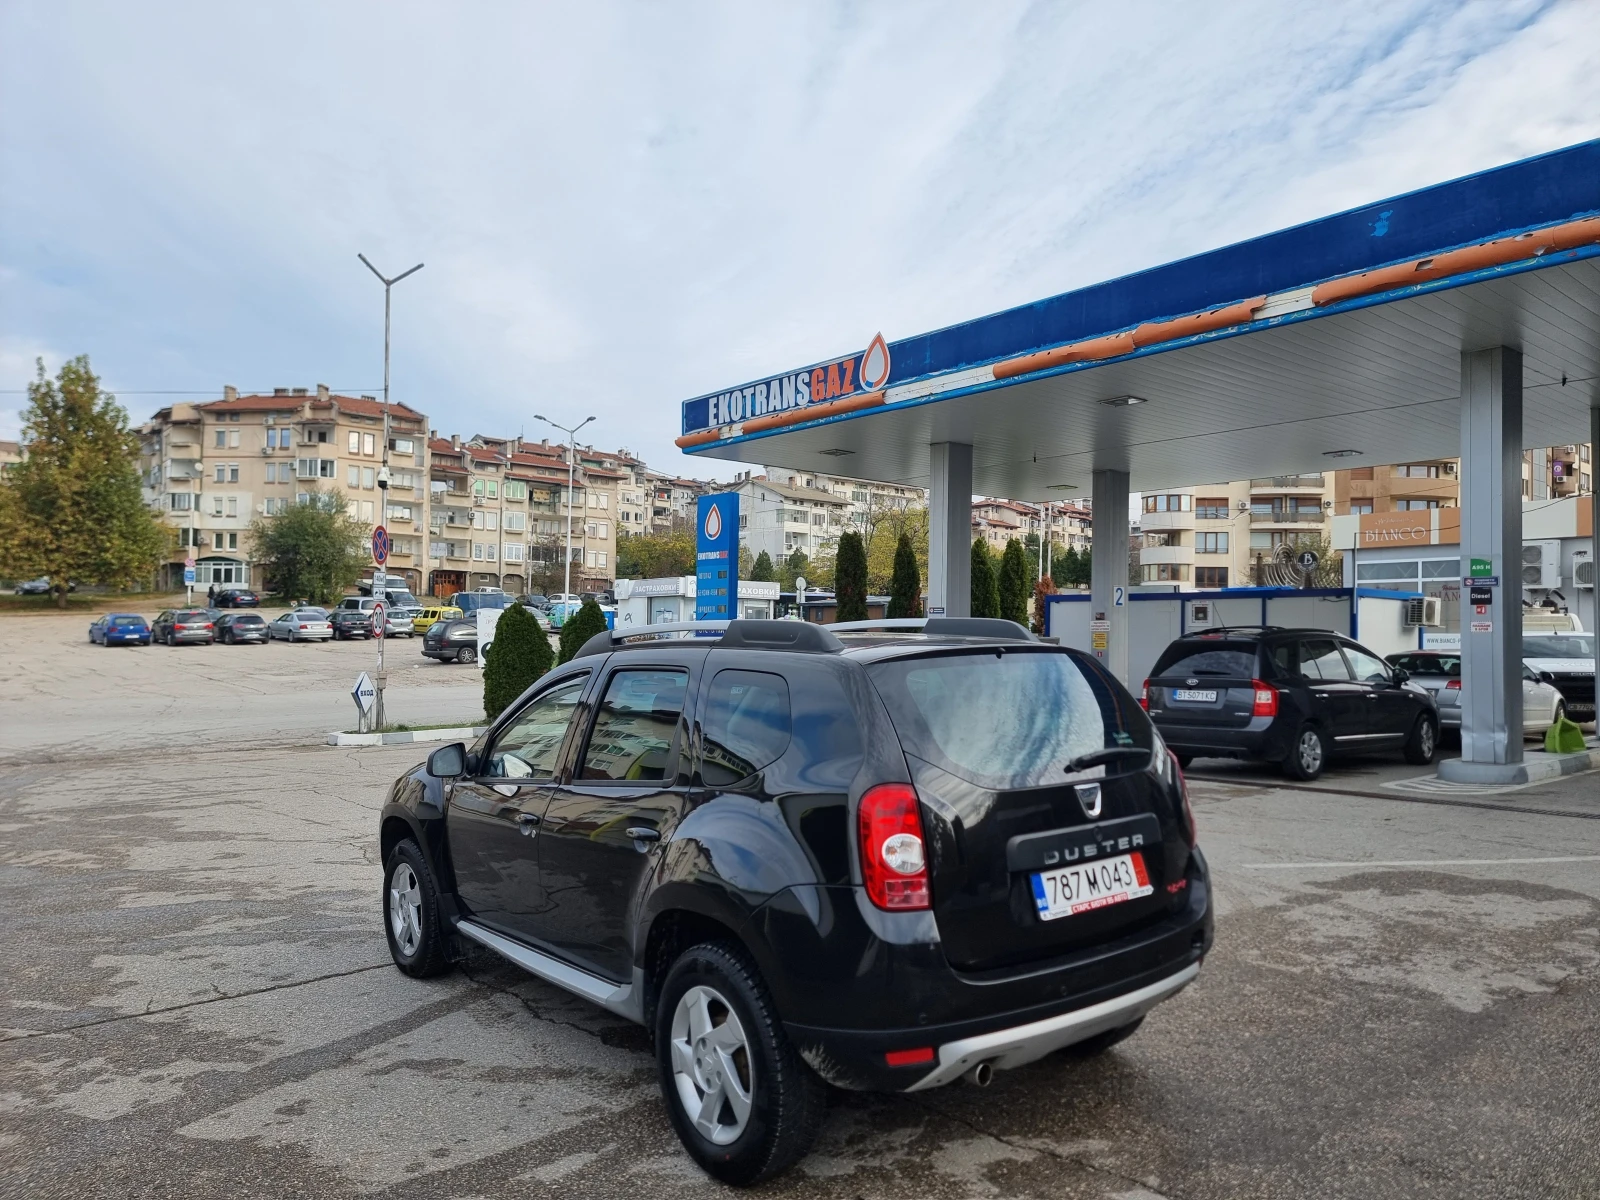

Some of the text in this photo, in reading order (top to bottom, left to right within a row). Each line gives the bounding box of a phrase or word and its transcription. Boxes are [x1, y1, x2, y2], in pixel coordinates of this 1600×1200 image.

[709, 359, 854, 426] EKOTRANSGAZ
[1365, 526, 1425, 541] BIANCO
[635, 584, 676, 593] ЗАСТРАХОВКИ
[1116, 588, 1123, 605] 2
[375, 612, 382, 629] 30
[360, 689, 374, 697] ВХОД
[1044, 834, 1144, 865] DUSTER
